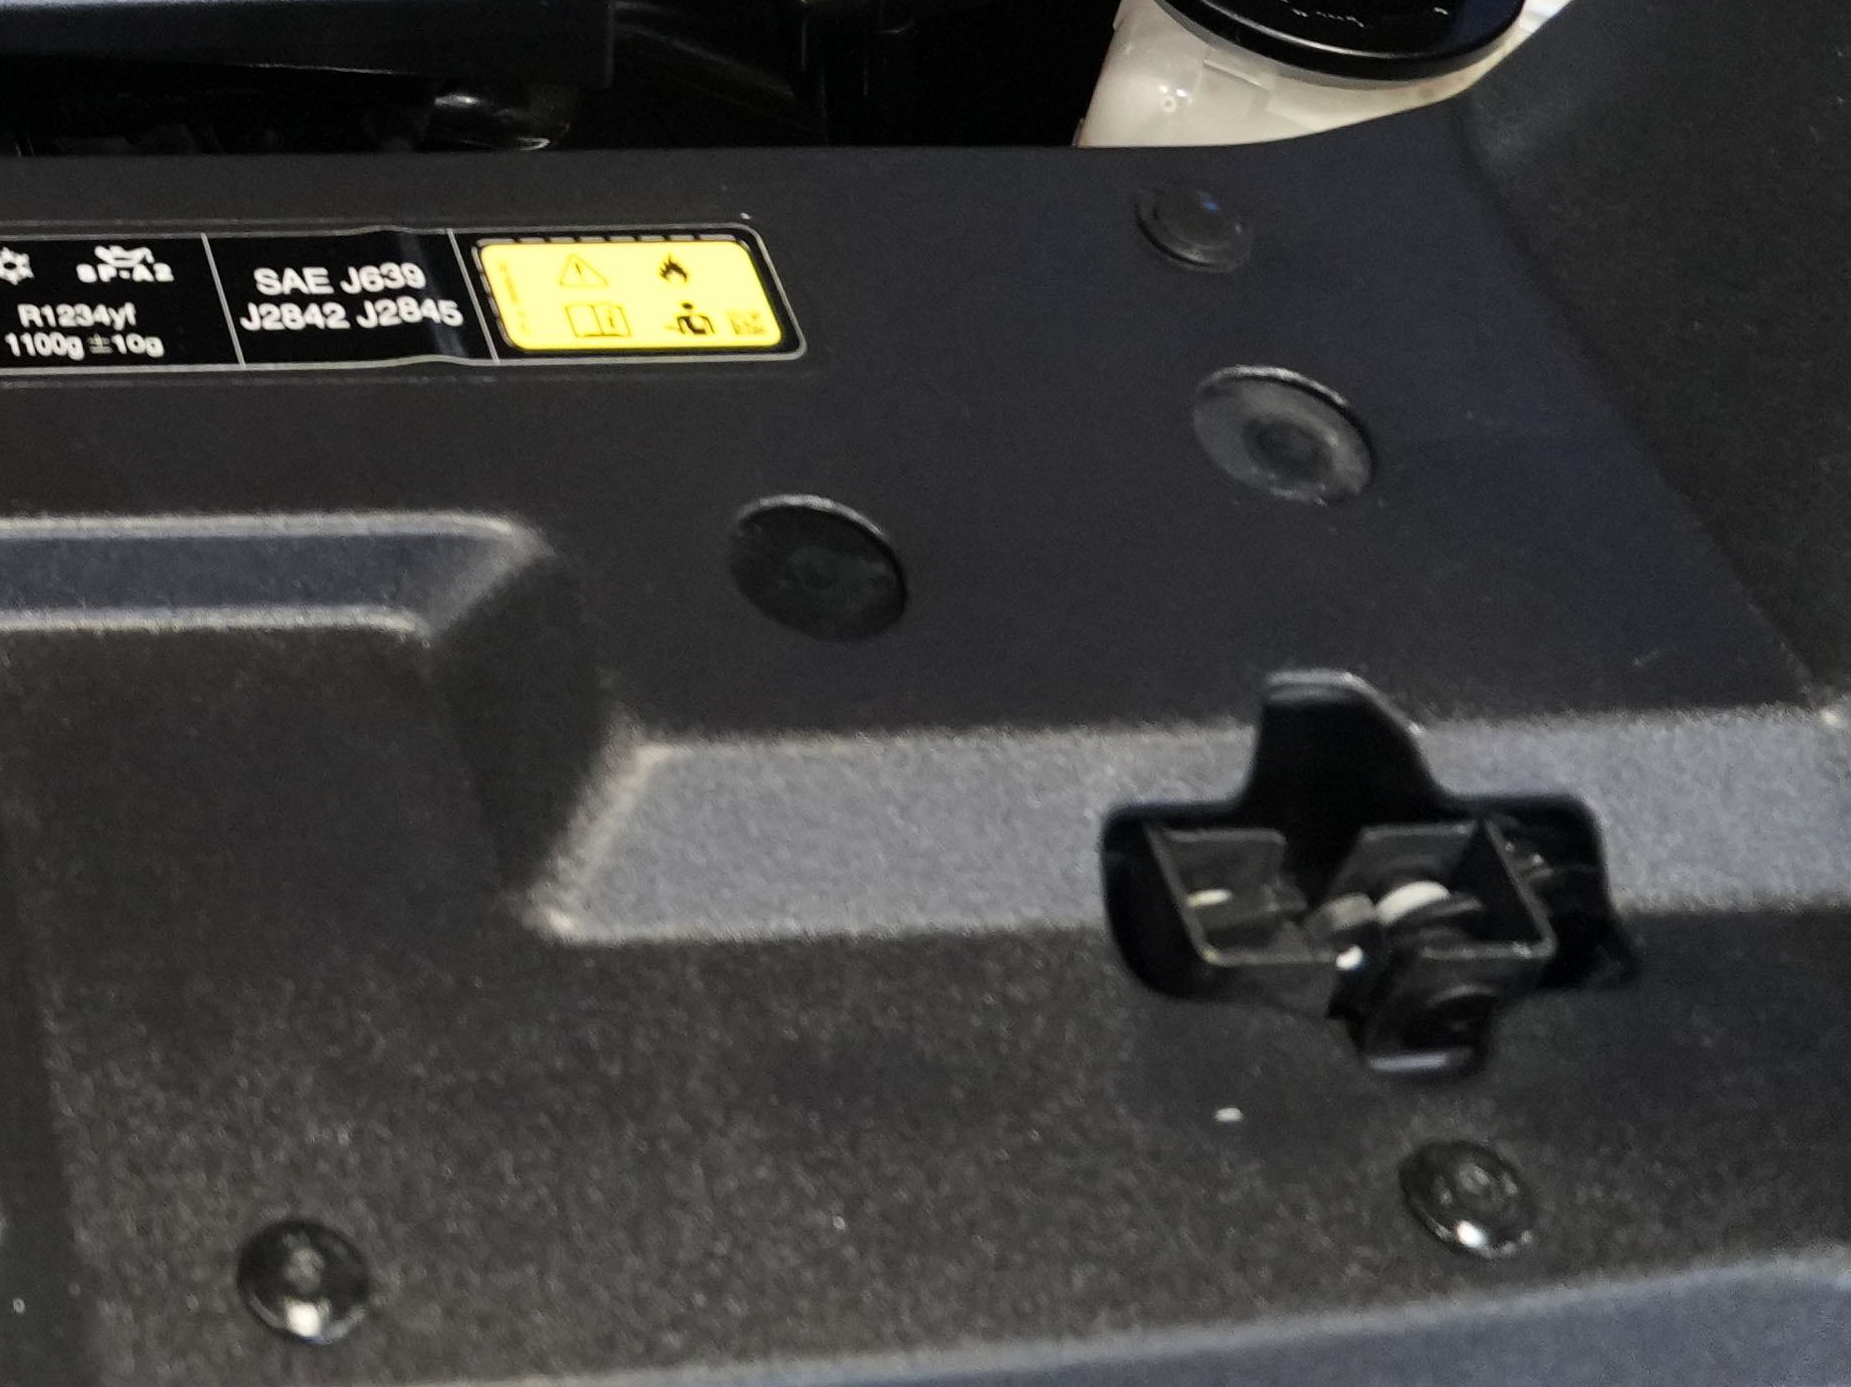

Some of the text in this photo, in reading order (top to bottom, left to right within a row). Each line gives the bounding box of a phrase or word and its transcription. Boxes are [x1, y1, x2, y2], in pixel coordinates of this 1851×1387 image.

[253, 262, 427, 296] SAE J639
[17, 302, 137, 331] R1234yf
[240, 295, 464, 331] J2842 J2845
[4, 331, 86, 361] 1100g
